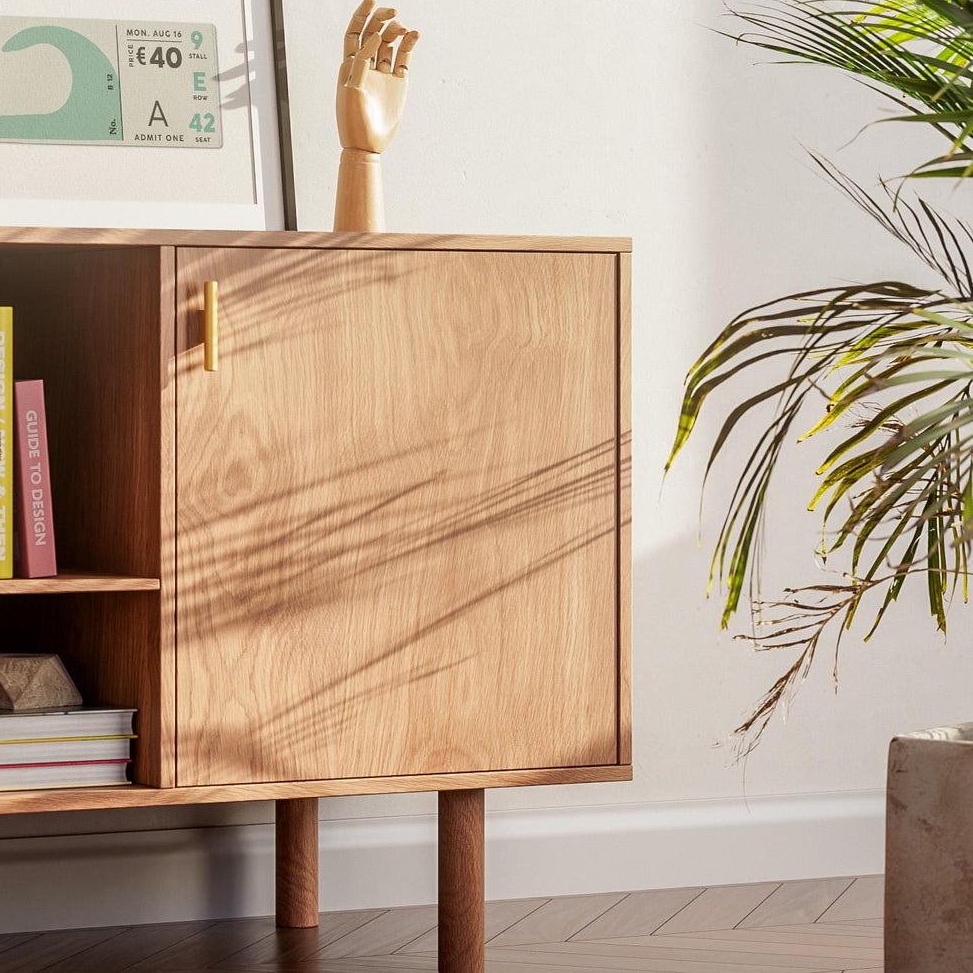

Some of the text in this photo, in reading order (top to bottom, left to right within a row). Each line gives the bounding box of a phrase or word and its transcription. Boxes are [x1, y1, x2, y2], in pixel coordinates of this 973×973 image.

[127, 29, 150, 37] MON.
[191, 31, 203, 50] 9
[193, 72, 207, 91] E
[148, 100, 168, 127] A
[189, 113, 215, 133] 42
[26, 410, 46, 546] GUIDE TO DESIGN
